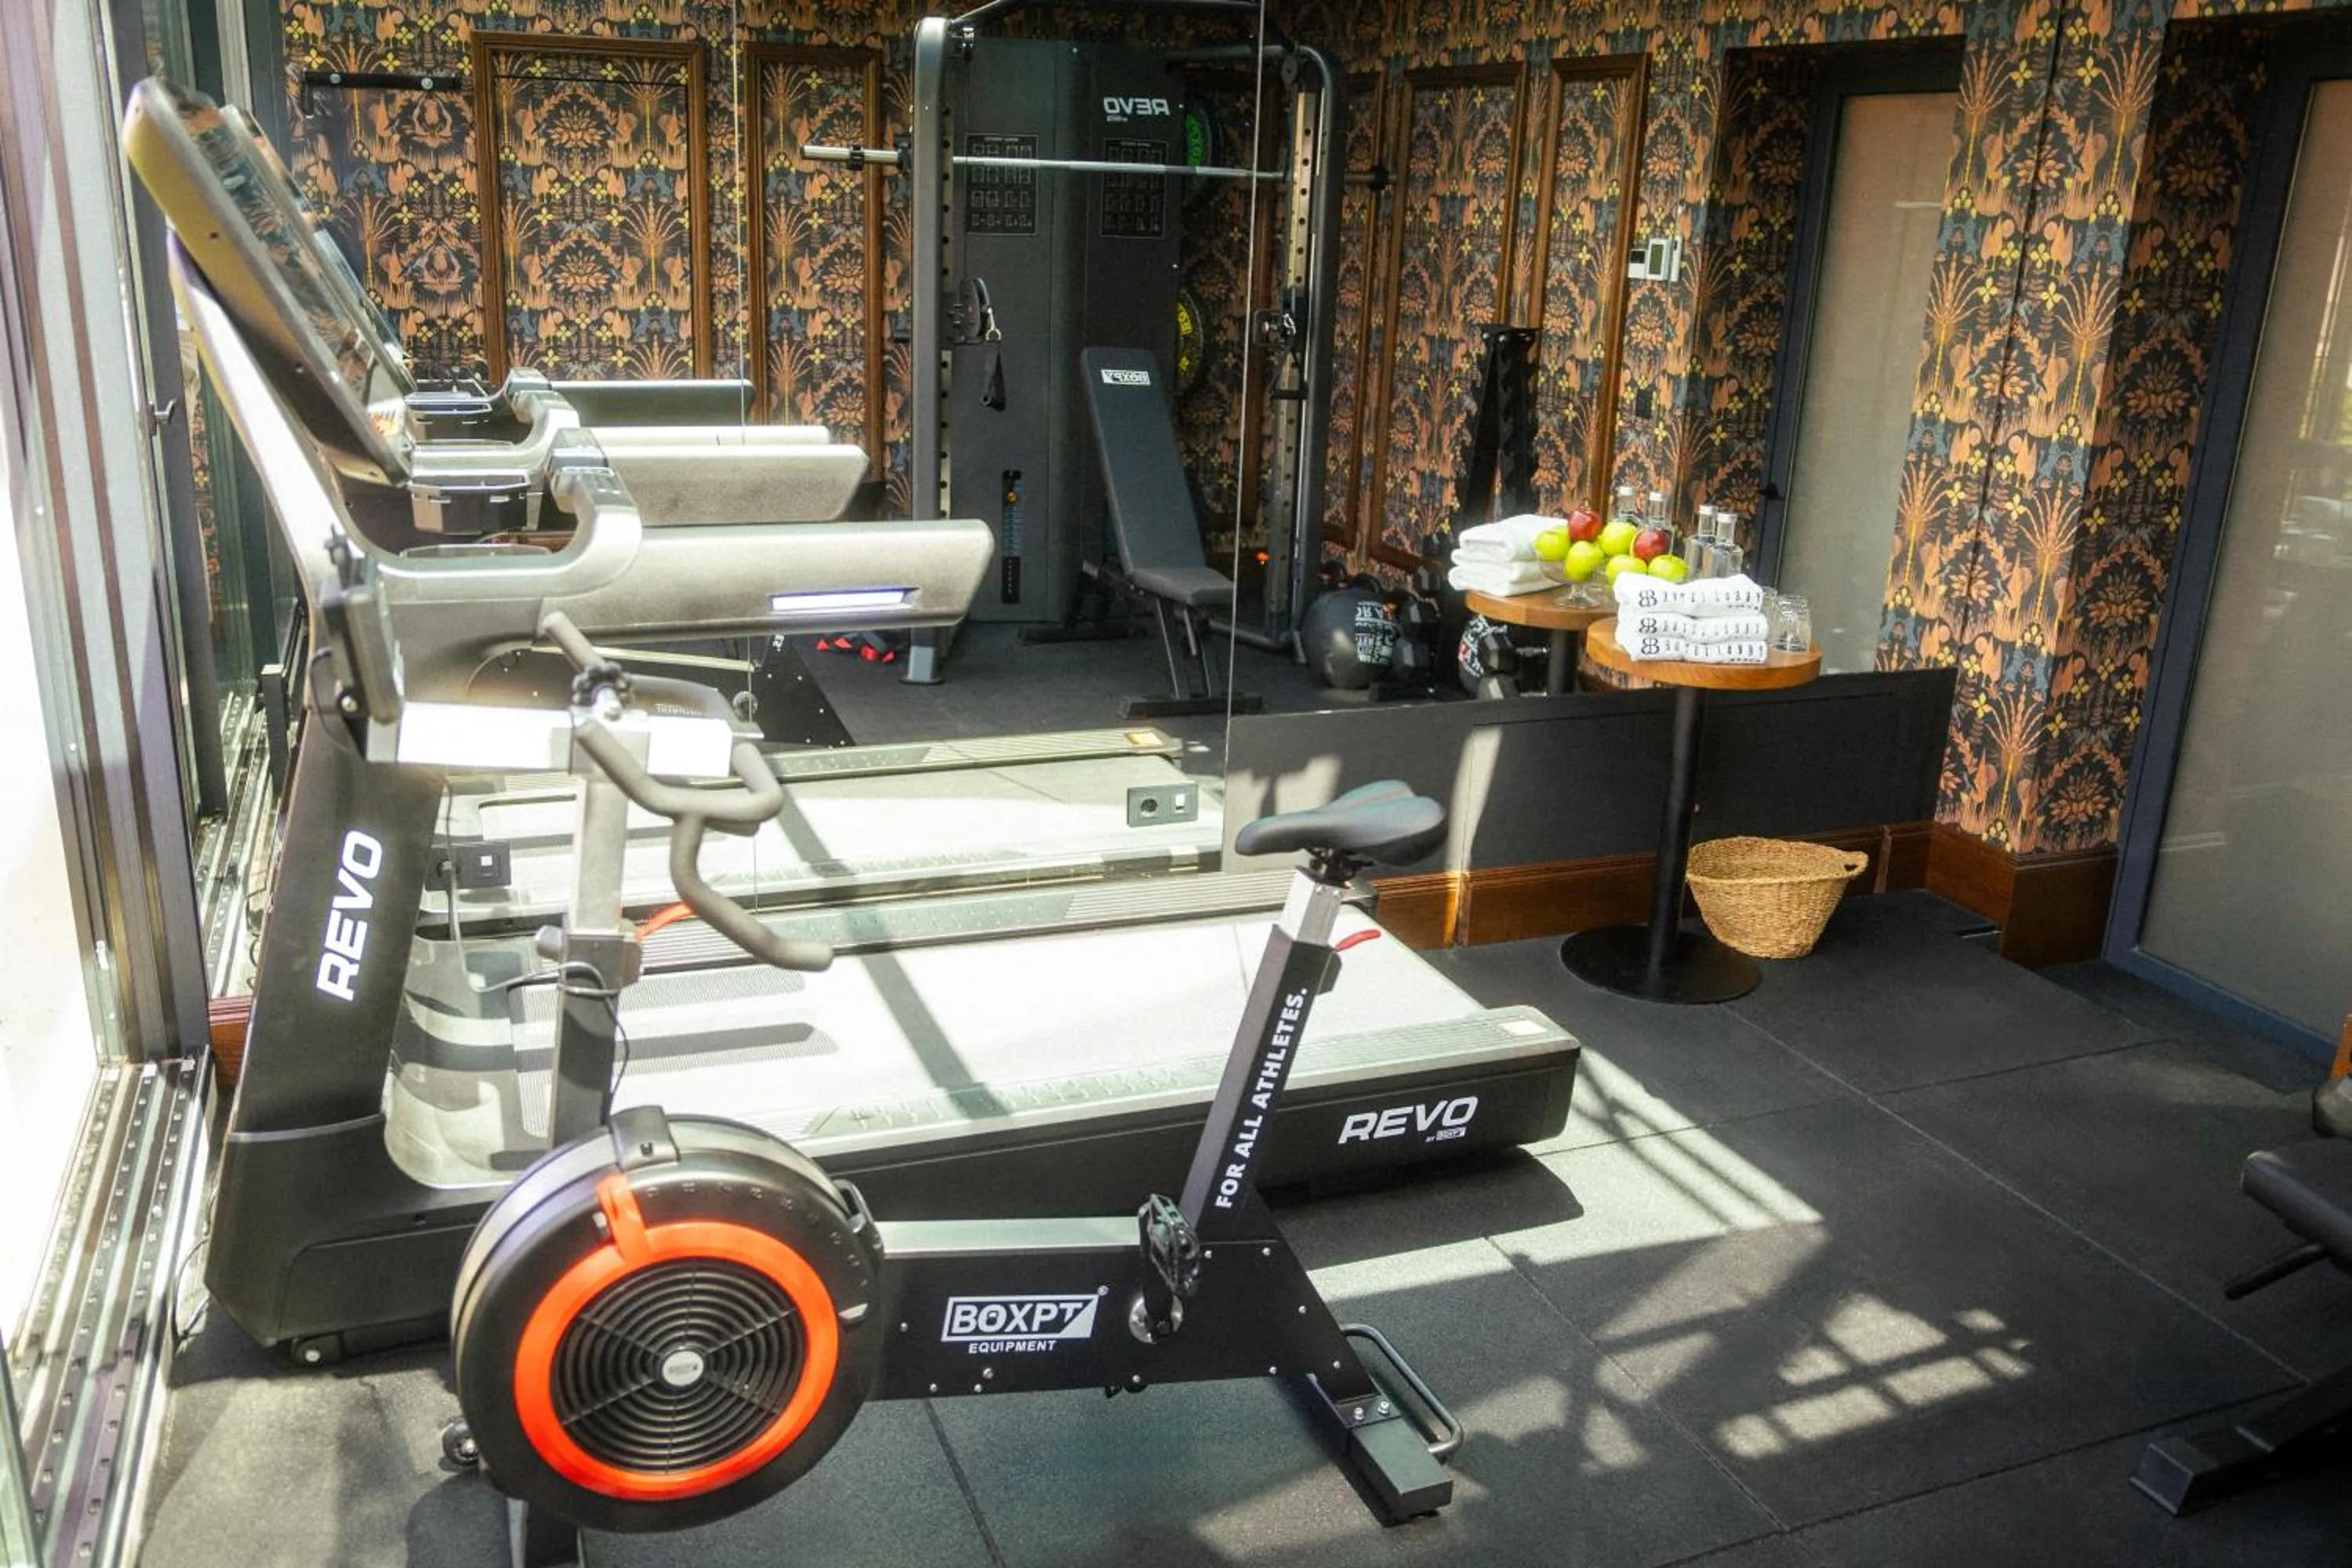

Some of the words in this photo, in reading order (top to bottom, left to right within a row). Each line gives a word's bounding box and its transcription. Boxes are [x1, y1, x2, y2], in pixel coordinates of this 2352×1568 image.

[316, 830, 383, 1001] REVO
[1215, 1163, 1246, 1209] FOR
[1234, 1114, 1263, 1158] ALL
[1251, 988, 1308, 1110] ATHLETES.
[1337, 1096, 1479, 1145] REVO
[950, 1301, 1083, 1334] BOXPT
[968, 1340, 1058, 1354] EQUIPMENT
